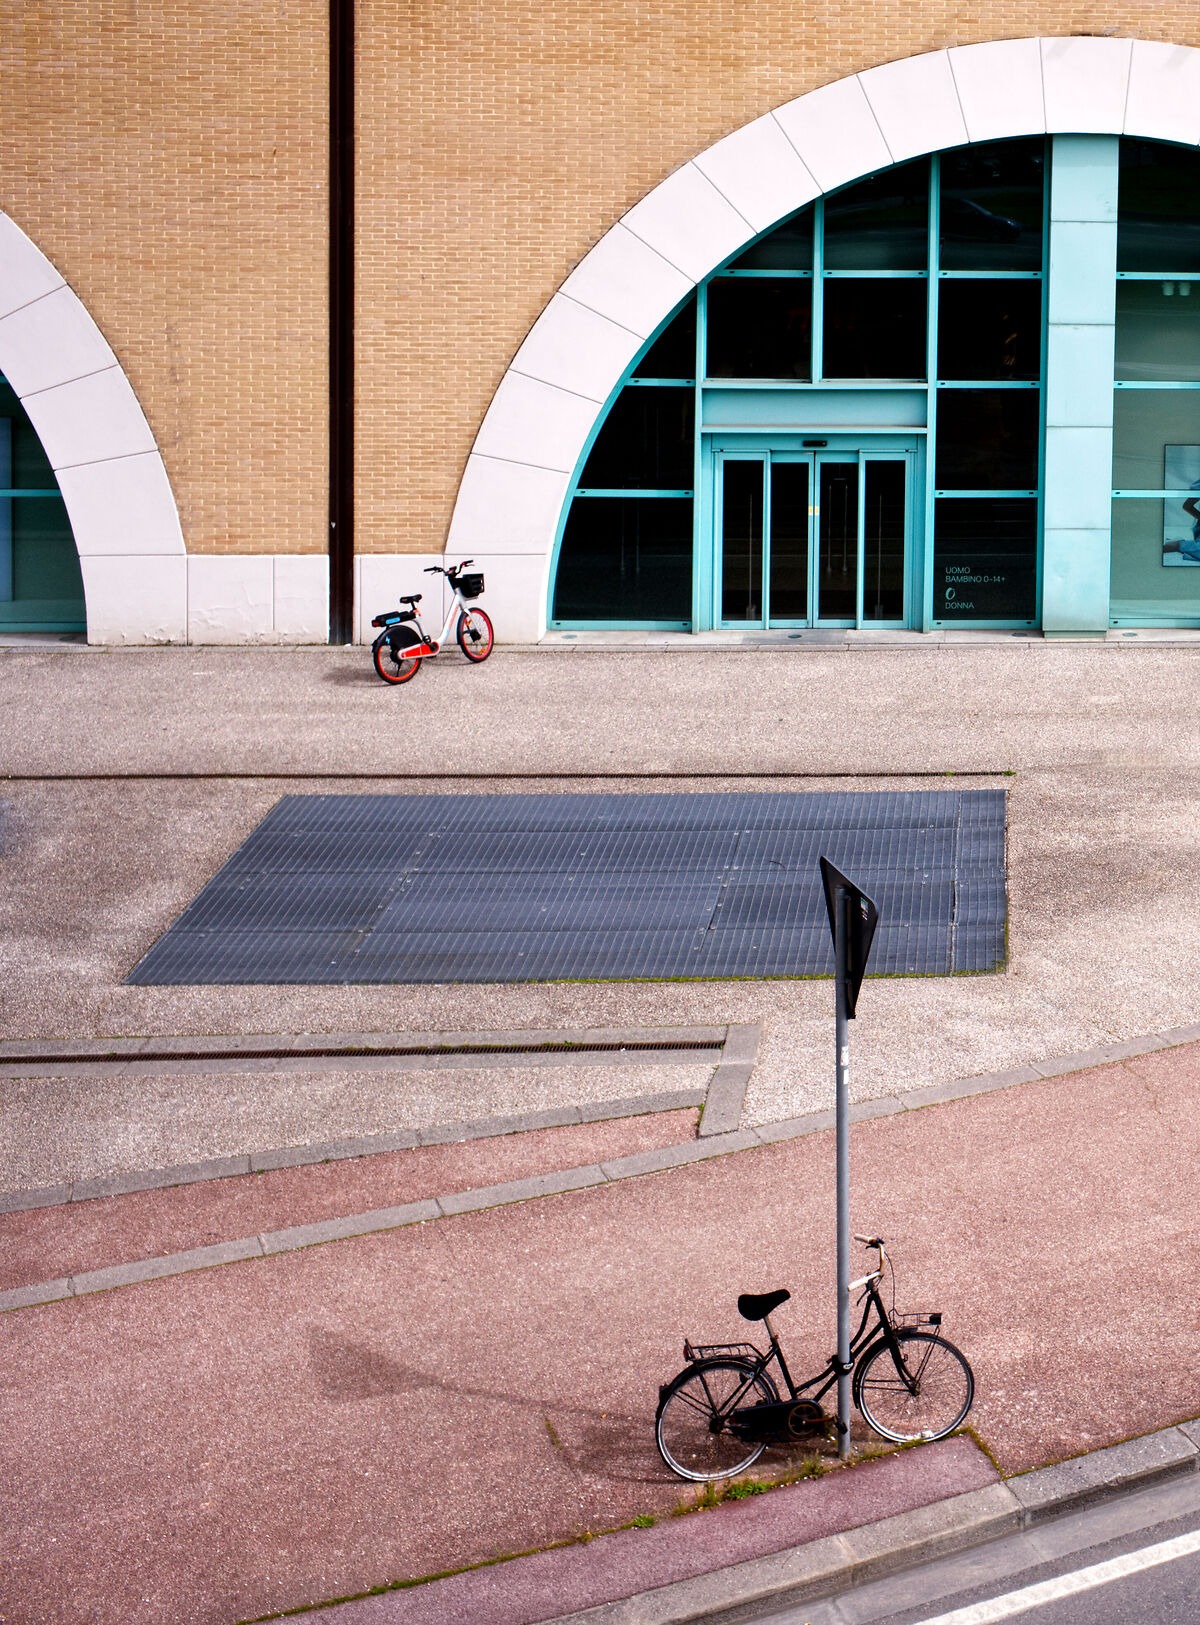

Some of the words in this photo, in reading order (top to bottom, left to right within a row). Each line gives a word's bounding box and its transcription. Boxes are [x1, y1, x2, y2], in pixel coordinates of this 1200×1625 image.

[945, 566, 971, 574] UOMO
[945, 575, 982, 583] BAMBINO
[945, 601, 975, 609] DONNA
